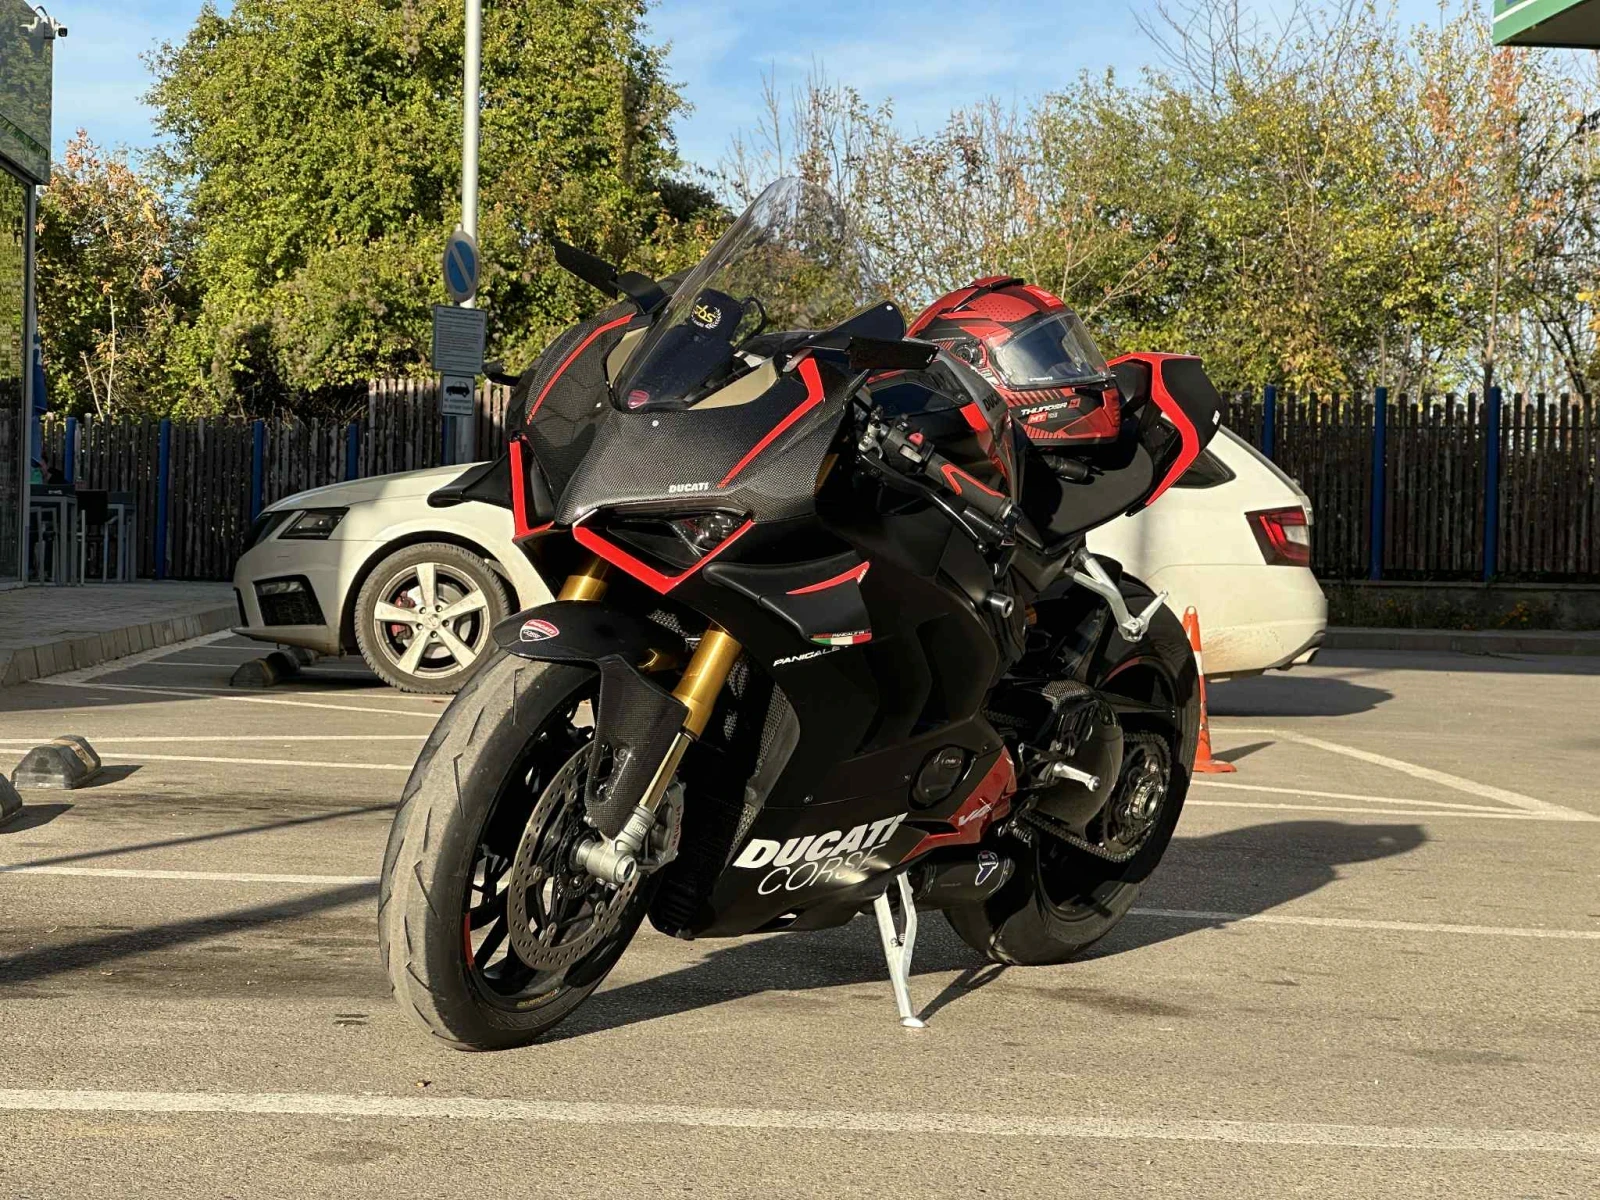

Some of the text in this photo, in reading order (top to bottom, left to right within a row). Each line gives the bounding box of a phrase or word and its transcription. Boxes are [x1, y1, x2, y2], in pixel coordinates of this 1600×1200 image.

[1020, 402, 1068, 415] THUNDER
[669, 482, 709, 493] DUCATI
[732, 812, 908, 869] DUCATI
[757, 843, 886, 895] CORSE
